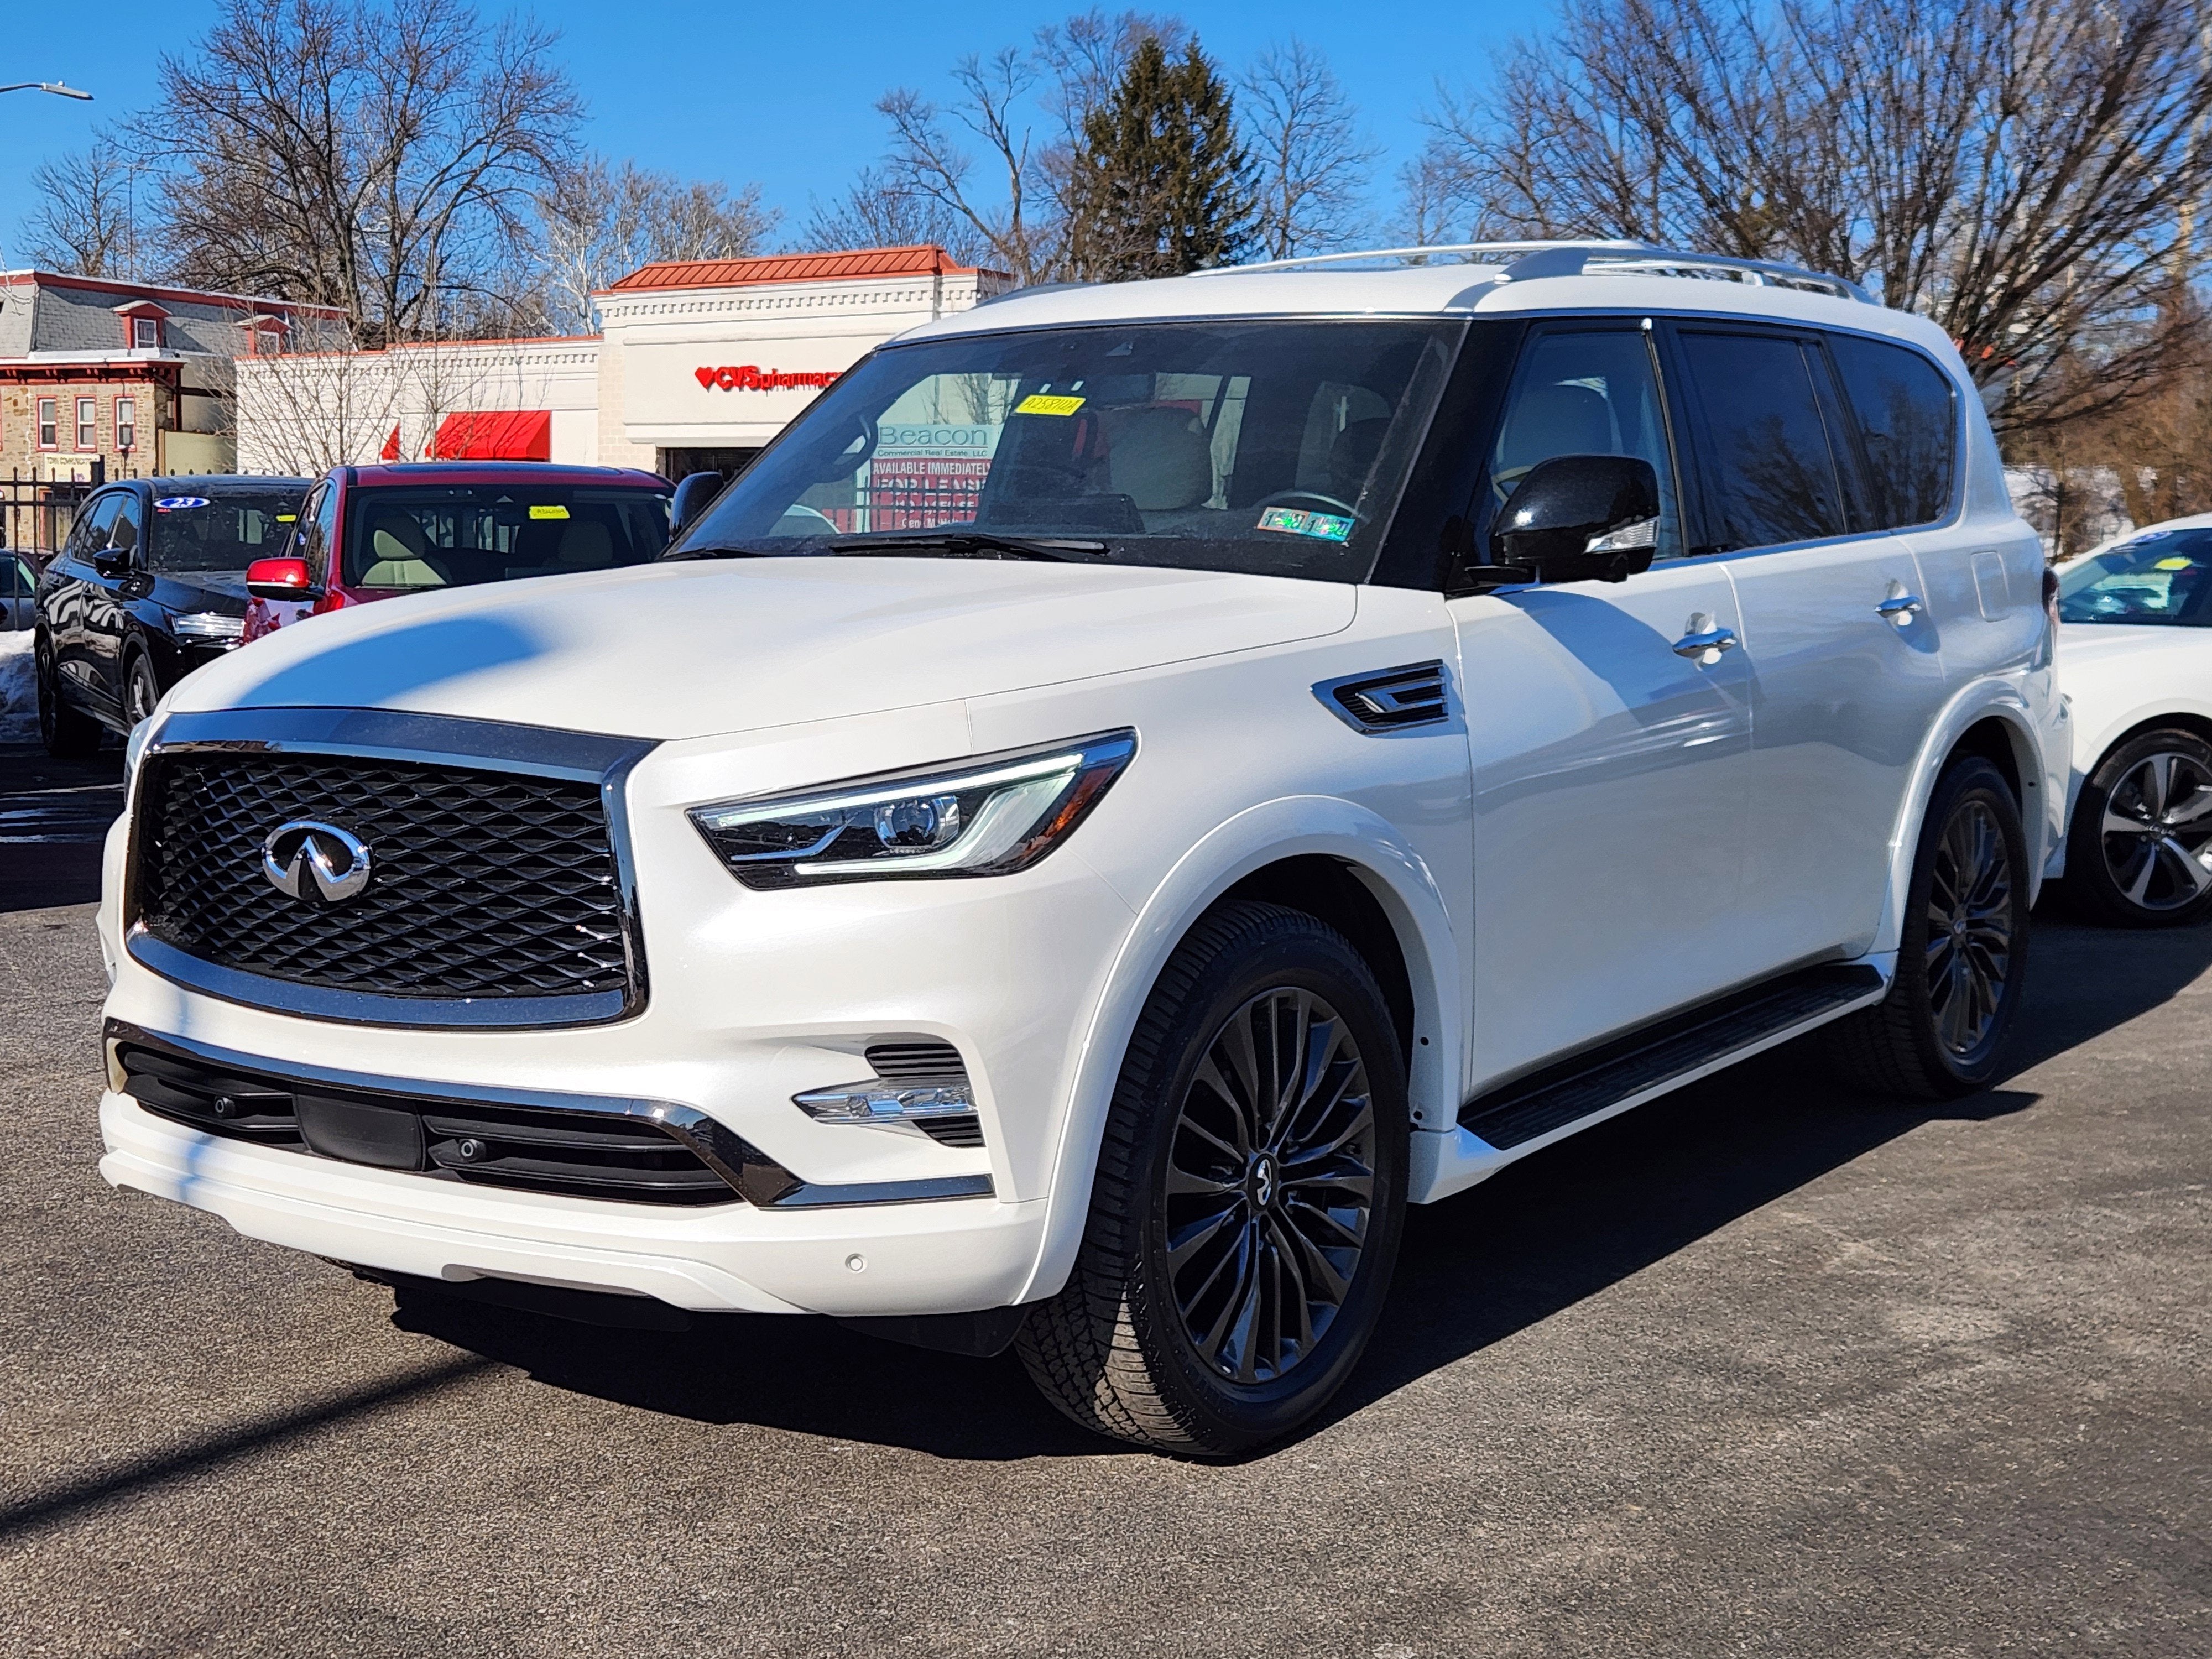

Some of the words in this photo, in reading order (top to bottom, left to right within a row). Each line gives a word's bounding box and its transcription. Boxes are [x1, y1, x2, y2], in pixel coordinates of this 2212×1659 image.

[879, 426, 988, 445] Beacon
[873, 462, 926, 475] AVAILABLE
[169, 497, 196, 508] 23
